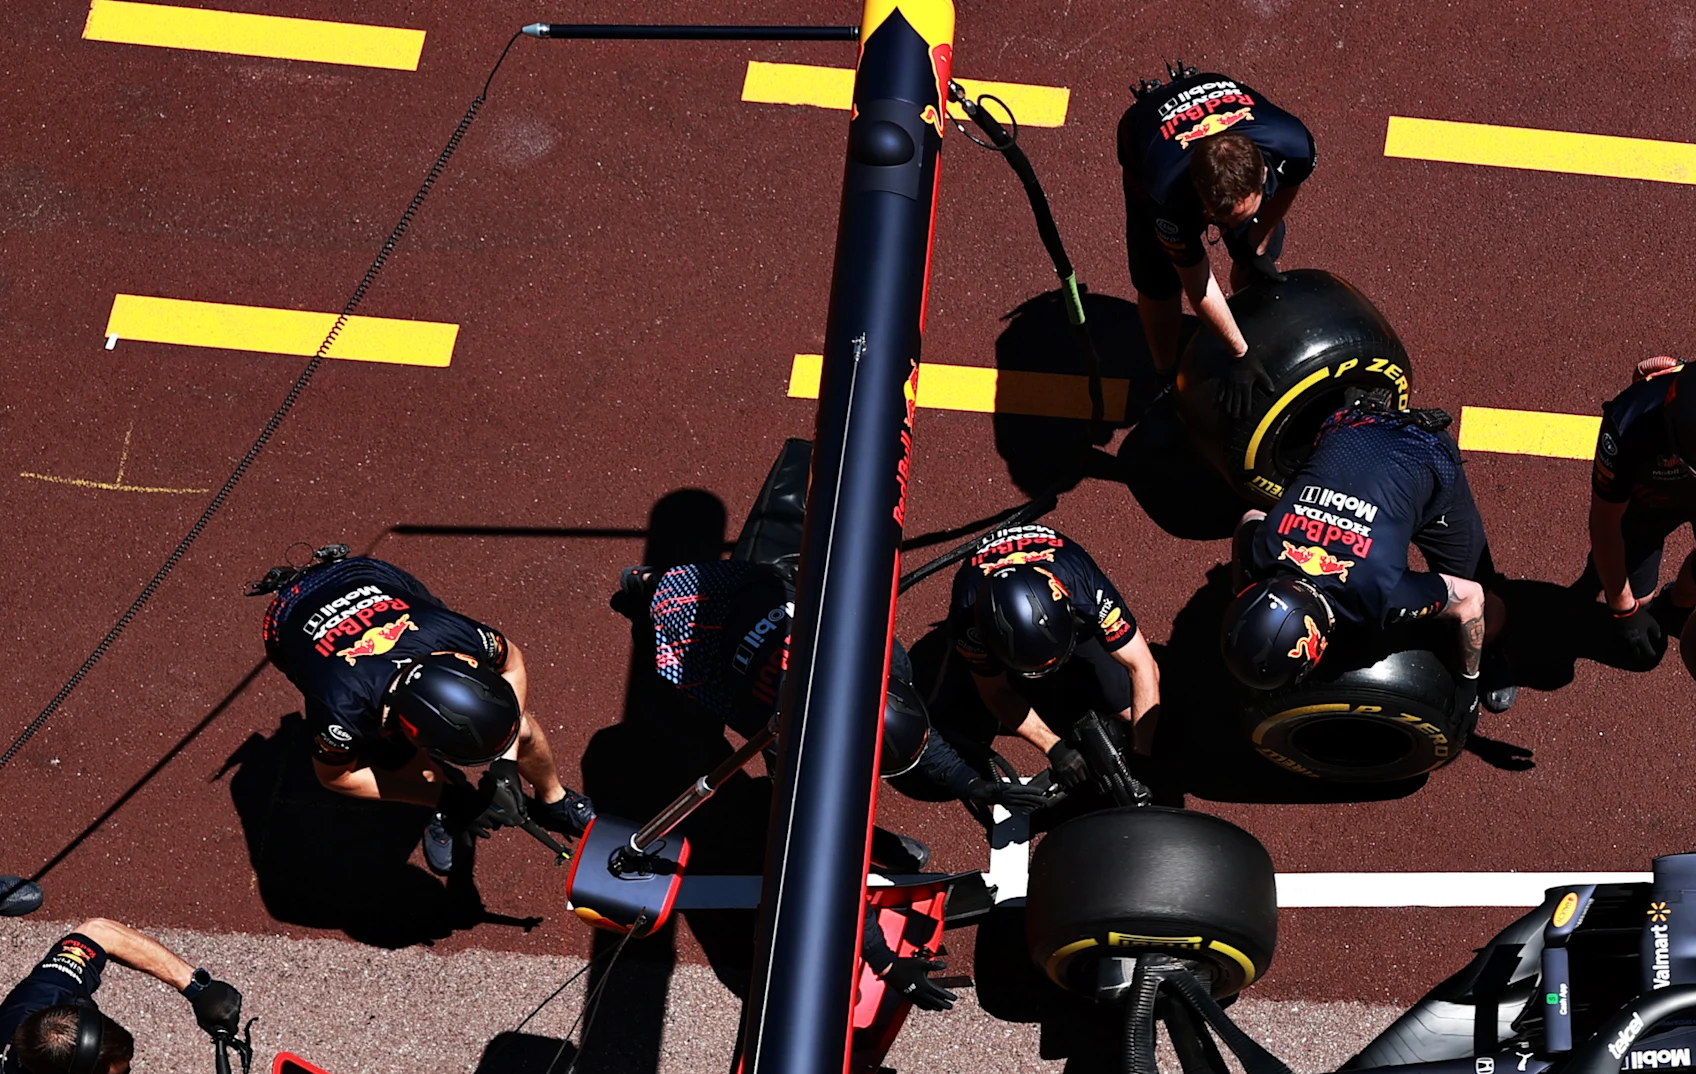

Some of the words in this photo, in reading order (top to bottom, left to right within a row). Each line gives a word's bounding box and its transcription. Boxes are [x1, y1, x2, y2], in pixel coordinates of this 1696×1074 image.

[1177, 80, 1236, 102] Mobil
[1208, 94, 1255, 113] Red
[1160, 102, 1210, 141] Bull
[1334, 358, 1359, 378] P
[1365, 357, 1409, 412] ZERO
[1293, 504, 1372, 537] HONDA
[1318, 489, 1378, 523] Mobil
[1277, 513, 1322, 543] Bull
[1320, 523, 1373, 559] Red
[313, 595, 394, 642] HONDA
[322, 584, 384, 619] Mobil
[361, 597, 411, 632] Red
[314, 617, 365, 658] Bull
[1607, 1011, 1645, 1061] telcel
[1631, 1048, 1691, 1070] Mobil
